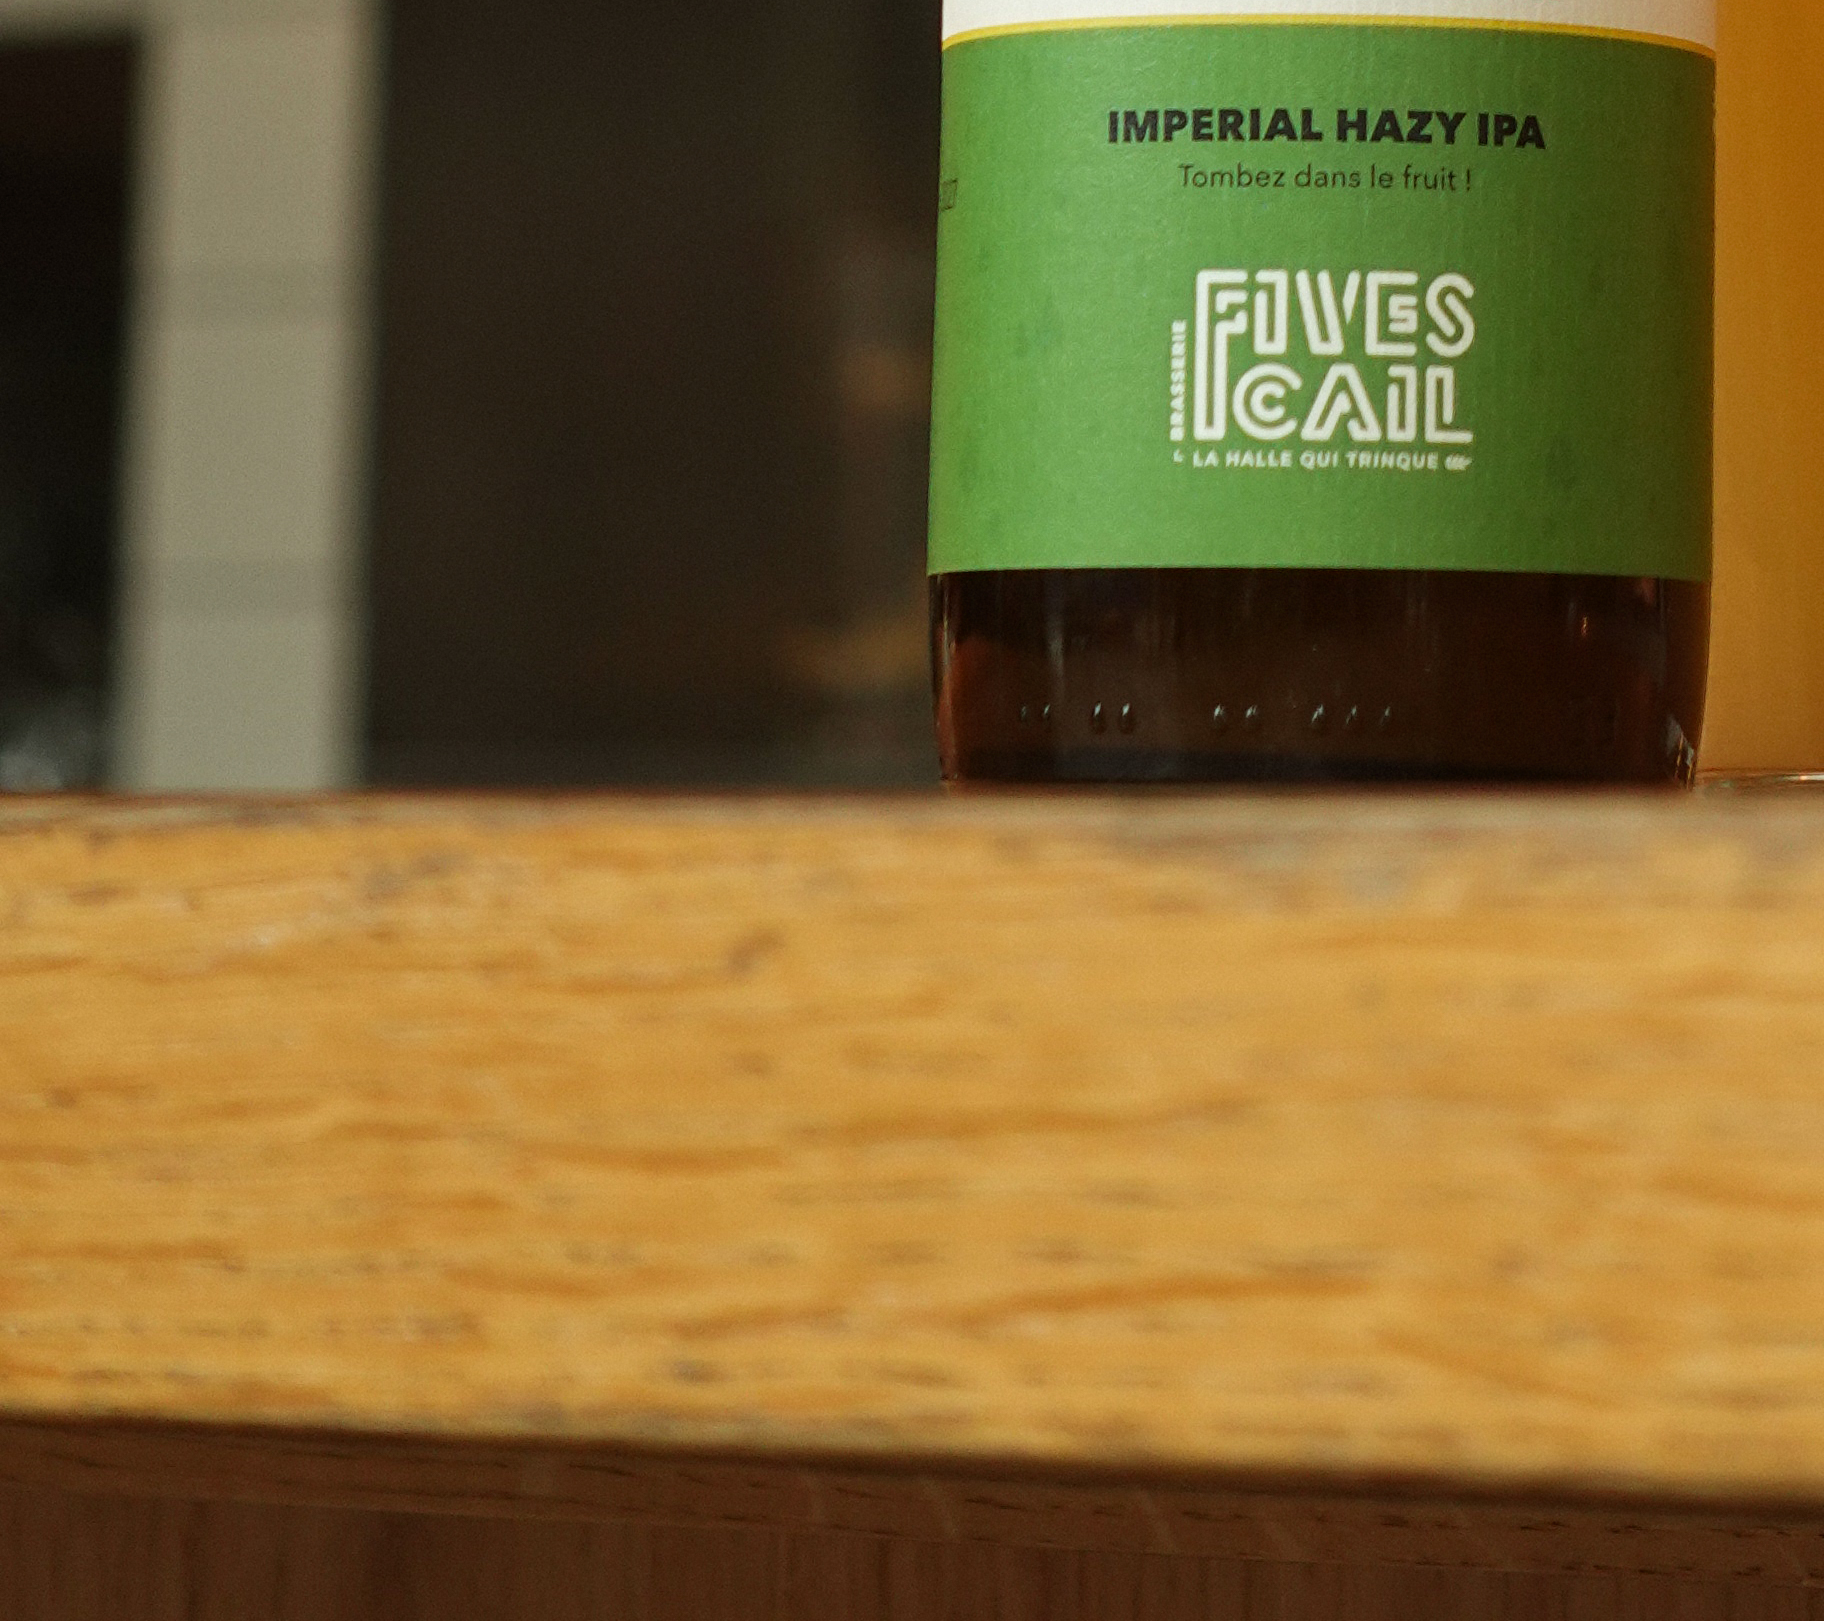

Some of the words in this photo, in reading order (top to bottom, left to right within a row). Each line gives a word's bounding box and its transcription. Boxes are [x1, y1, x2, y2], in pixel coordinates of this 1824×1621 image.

[1108, 107, 1325, 144] IMPERIAL
[1336, 108, 1468, 146] HAZY
[1477, 112, 1547, 150] IPA
[1178, 161, 1286, 189] Tombez
[1294, 163, 1362, 189] dans
[1370, 163, 1395, 190] le
[1402, 163, 1457, 193] fruit
[1465, 168, 1472, 192] !
[1168, 317, 1188, 443] BRASSERIE
[1193, 268, 1476, 443] FIVES
[1232, 361, 1474, 445] CAIL
[1192, 448, 1220, 469] LA
[1224, 449, 1294, 469] HALLE
[1299, 449, 1340, 471] QUI
[1344, 450, 1440, 472] TRINQUE
